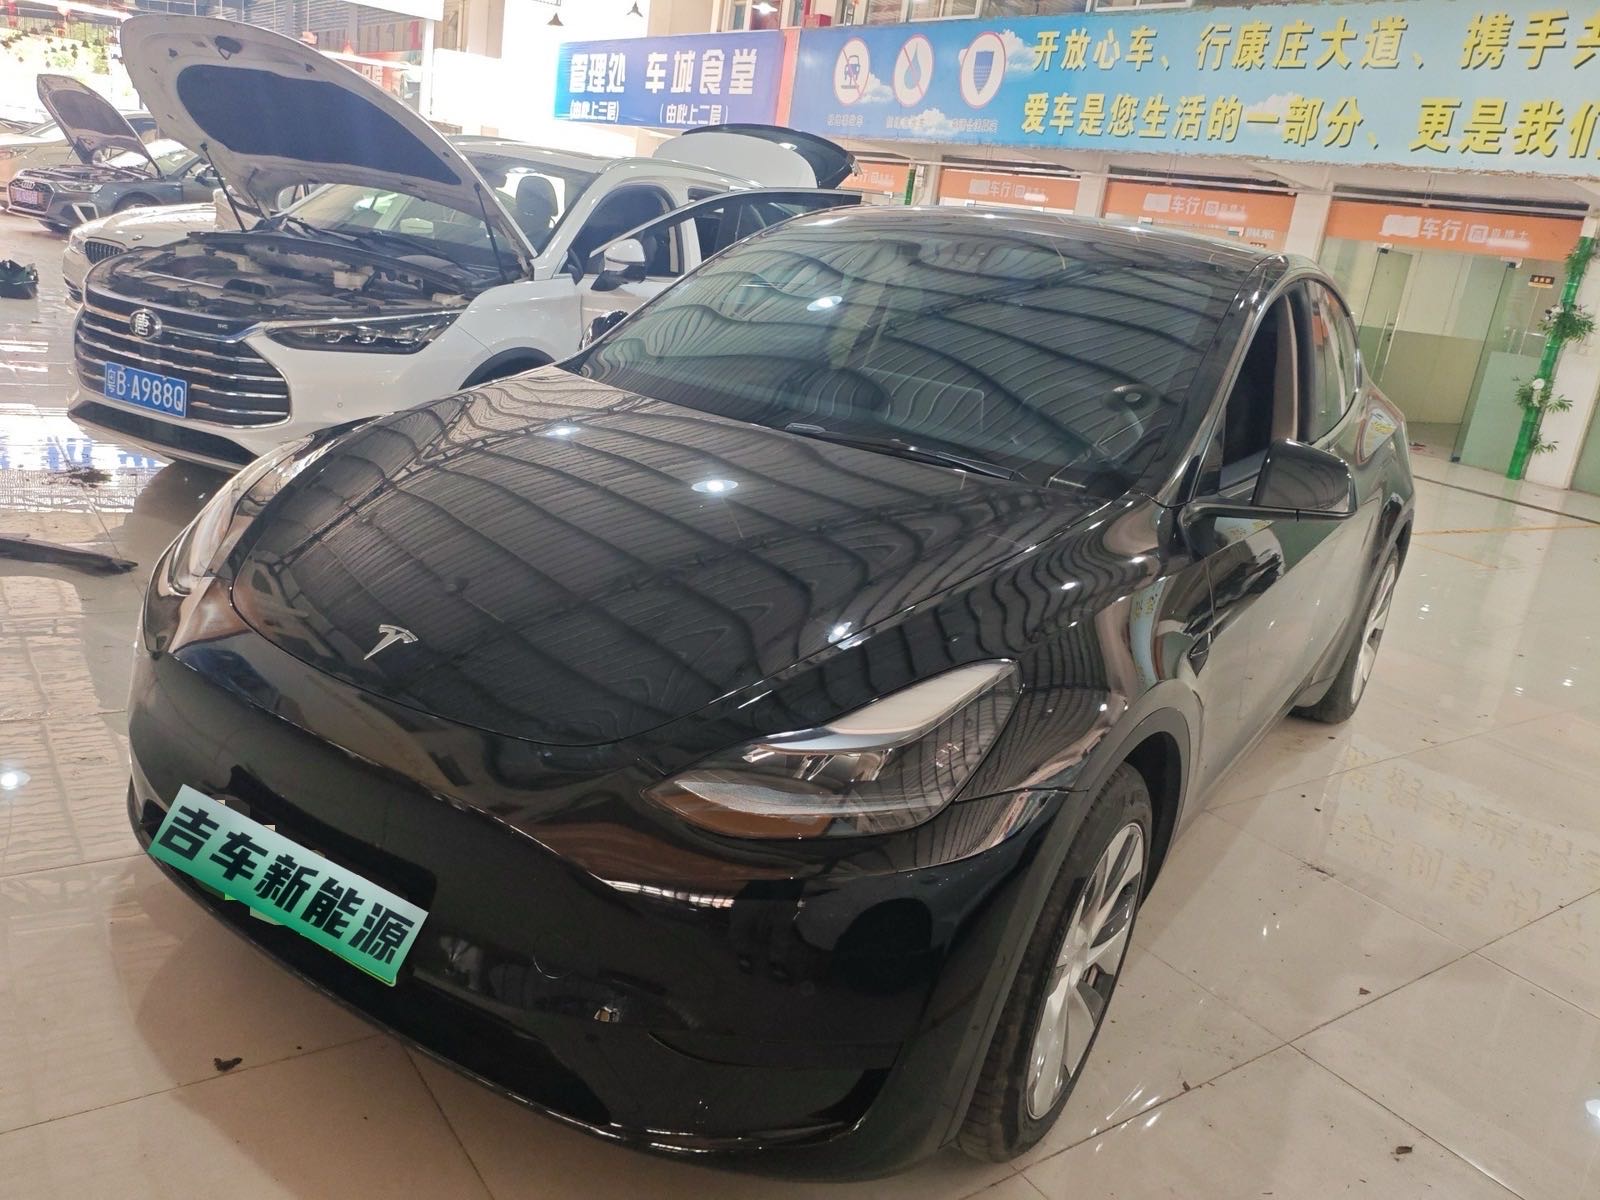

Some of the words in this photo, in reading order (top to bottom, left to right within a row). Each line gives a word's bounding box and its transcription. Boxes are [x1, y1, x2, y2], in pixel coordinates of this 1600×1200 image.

[569, 53, 626, 94] 管理处
[645, 48, 758, 95] 车城食堂
[1171, 194, 1201, 216] 车行
[1420, 217, 1462, 242] 车行
